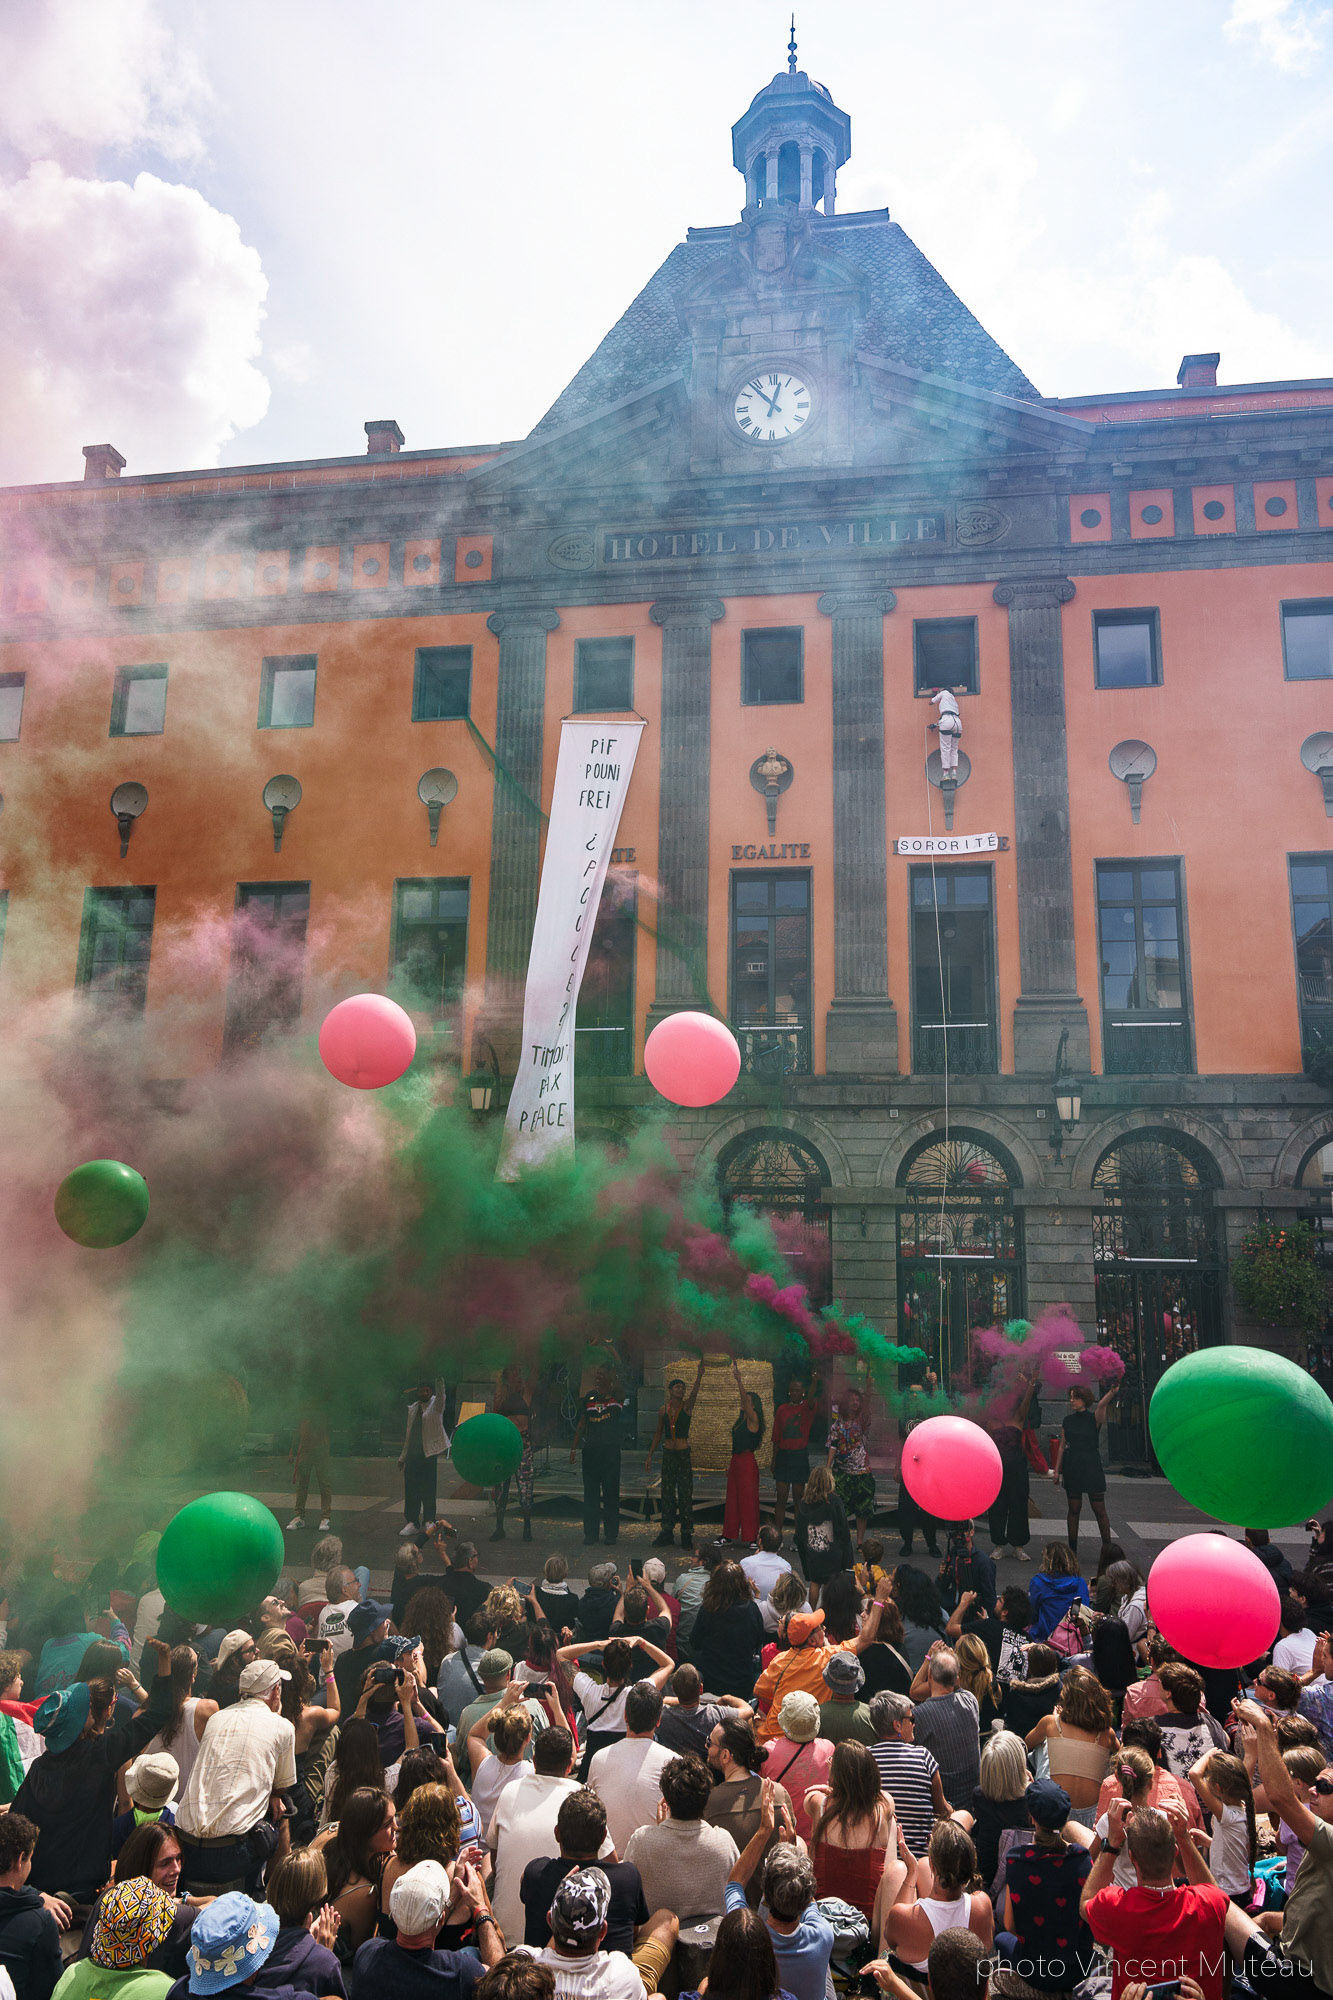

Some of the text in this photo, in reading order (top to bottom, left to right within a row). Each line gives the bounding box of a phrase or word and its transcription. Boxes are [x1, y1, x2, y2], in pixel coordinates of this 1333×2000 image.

[610, 518, 937, 560] HOTEL DE VILLE
[731, 843, 811, 860] EGALITE
[900, 834, 997, 851] SORORITÉ
[519, 1102, 568, 1132] PEACE
